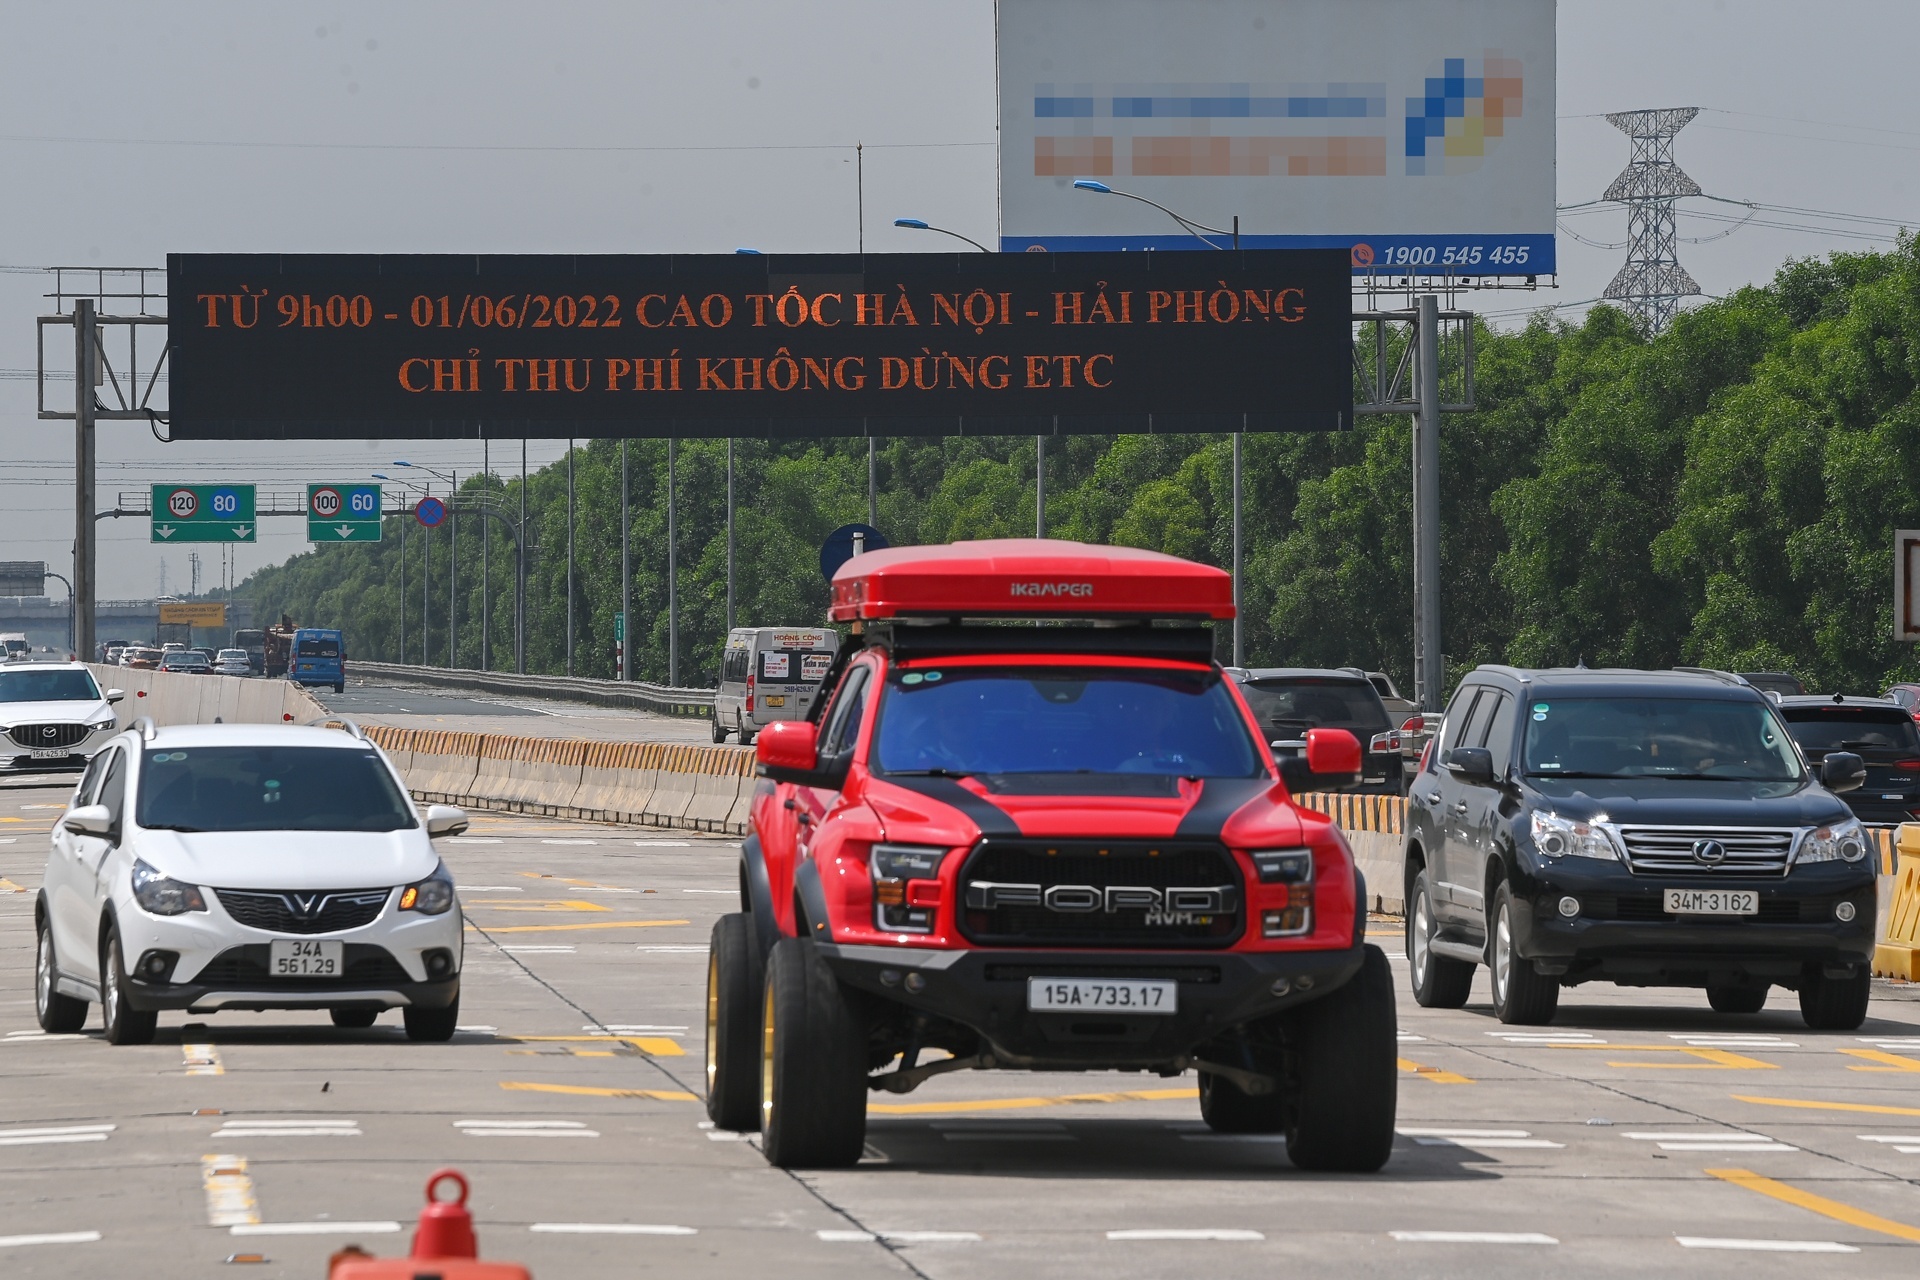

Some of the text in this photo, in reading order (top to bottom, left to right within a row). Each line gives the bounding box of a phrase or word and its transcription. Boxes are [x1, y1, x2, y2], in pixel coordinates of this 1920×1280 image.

[1384, 246, 1530, 265] 1900 545 455
[197, 284, 269, 329] TỪ
[277, 294, 373, 328] 9h00
[411, 294, 621, 328] 01/06/2022
[635, 293, 734, 328] CAO
[745, 285, 842, 328] TỐC
[853, 284, 919, 327] HÀ
[931, 288, 1012, 335] NỘI
[1052, 281, 1133, 325] HẢI
[1147, 280, 1307, 324] PHÒNG
[398, 346, 1115, 393] CHỈ THU PHÍ KHÔNG DỪNG ETC
[171, 495, 236, 512] 120 80
[315, 493, 373, 511] 100 60
[966, 881, 1237, 914] FORD
[1670, 892, 1752, 911] 34M-3162
[292, 941, 322, 957] 34A
[278, 958, 335, 974] 561.29
